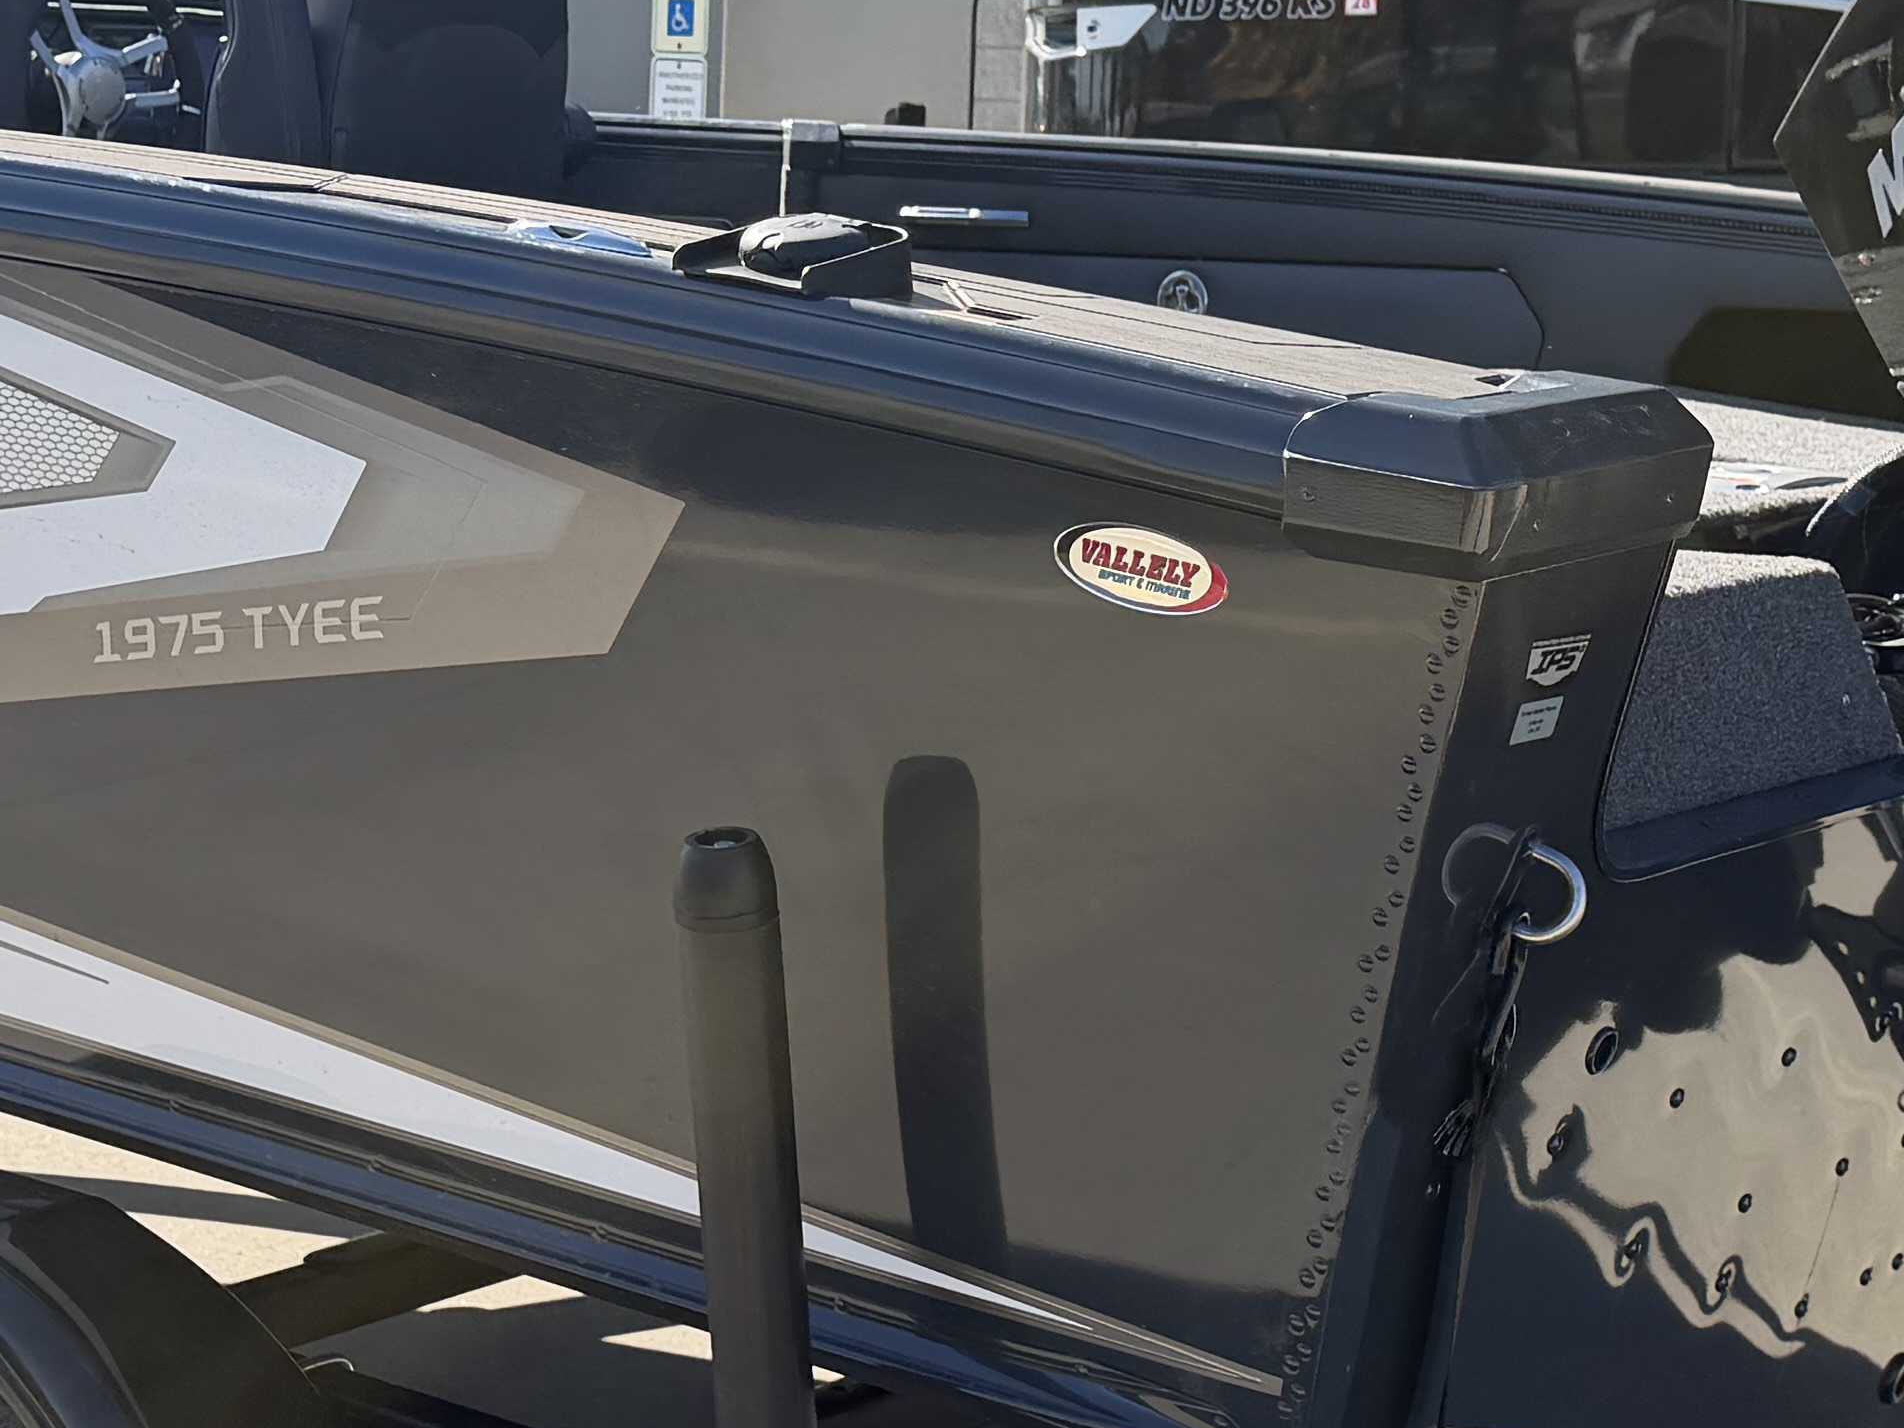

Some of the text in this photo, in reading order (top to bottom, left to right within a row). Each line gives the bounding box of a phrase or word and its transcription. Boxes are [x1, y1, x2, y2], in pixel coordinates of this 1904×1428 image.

[1081, 538, 1201, 589] VALLELY
[94, 595, 385, 664] 1975 TYEE
[1530, 645, 1581, 675] IPS
